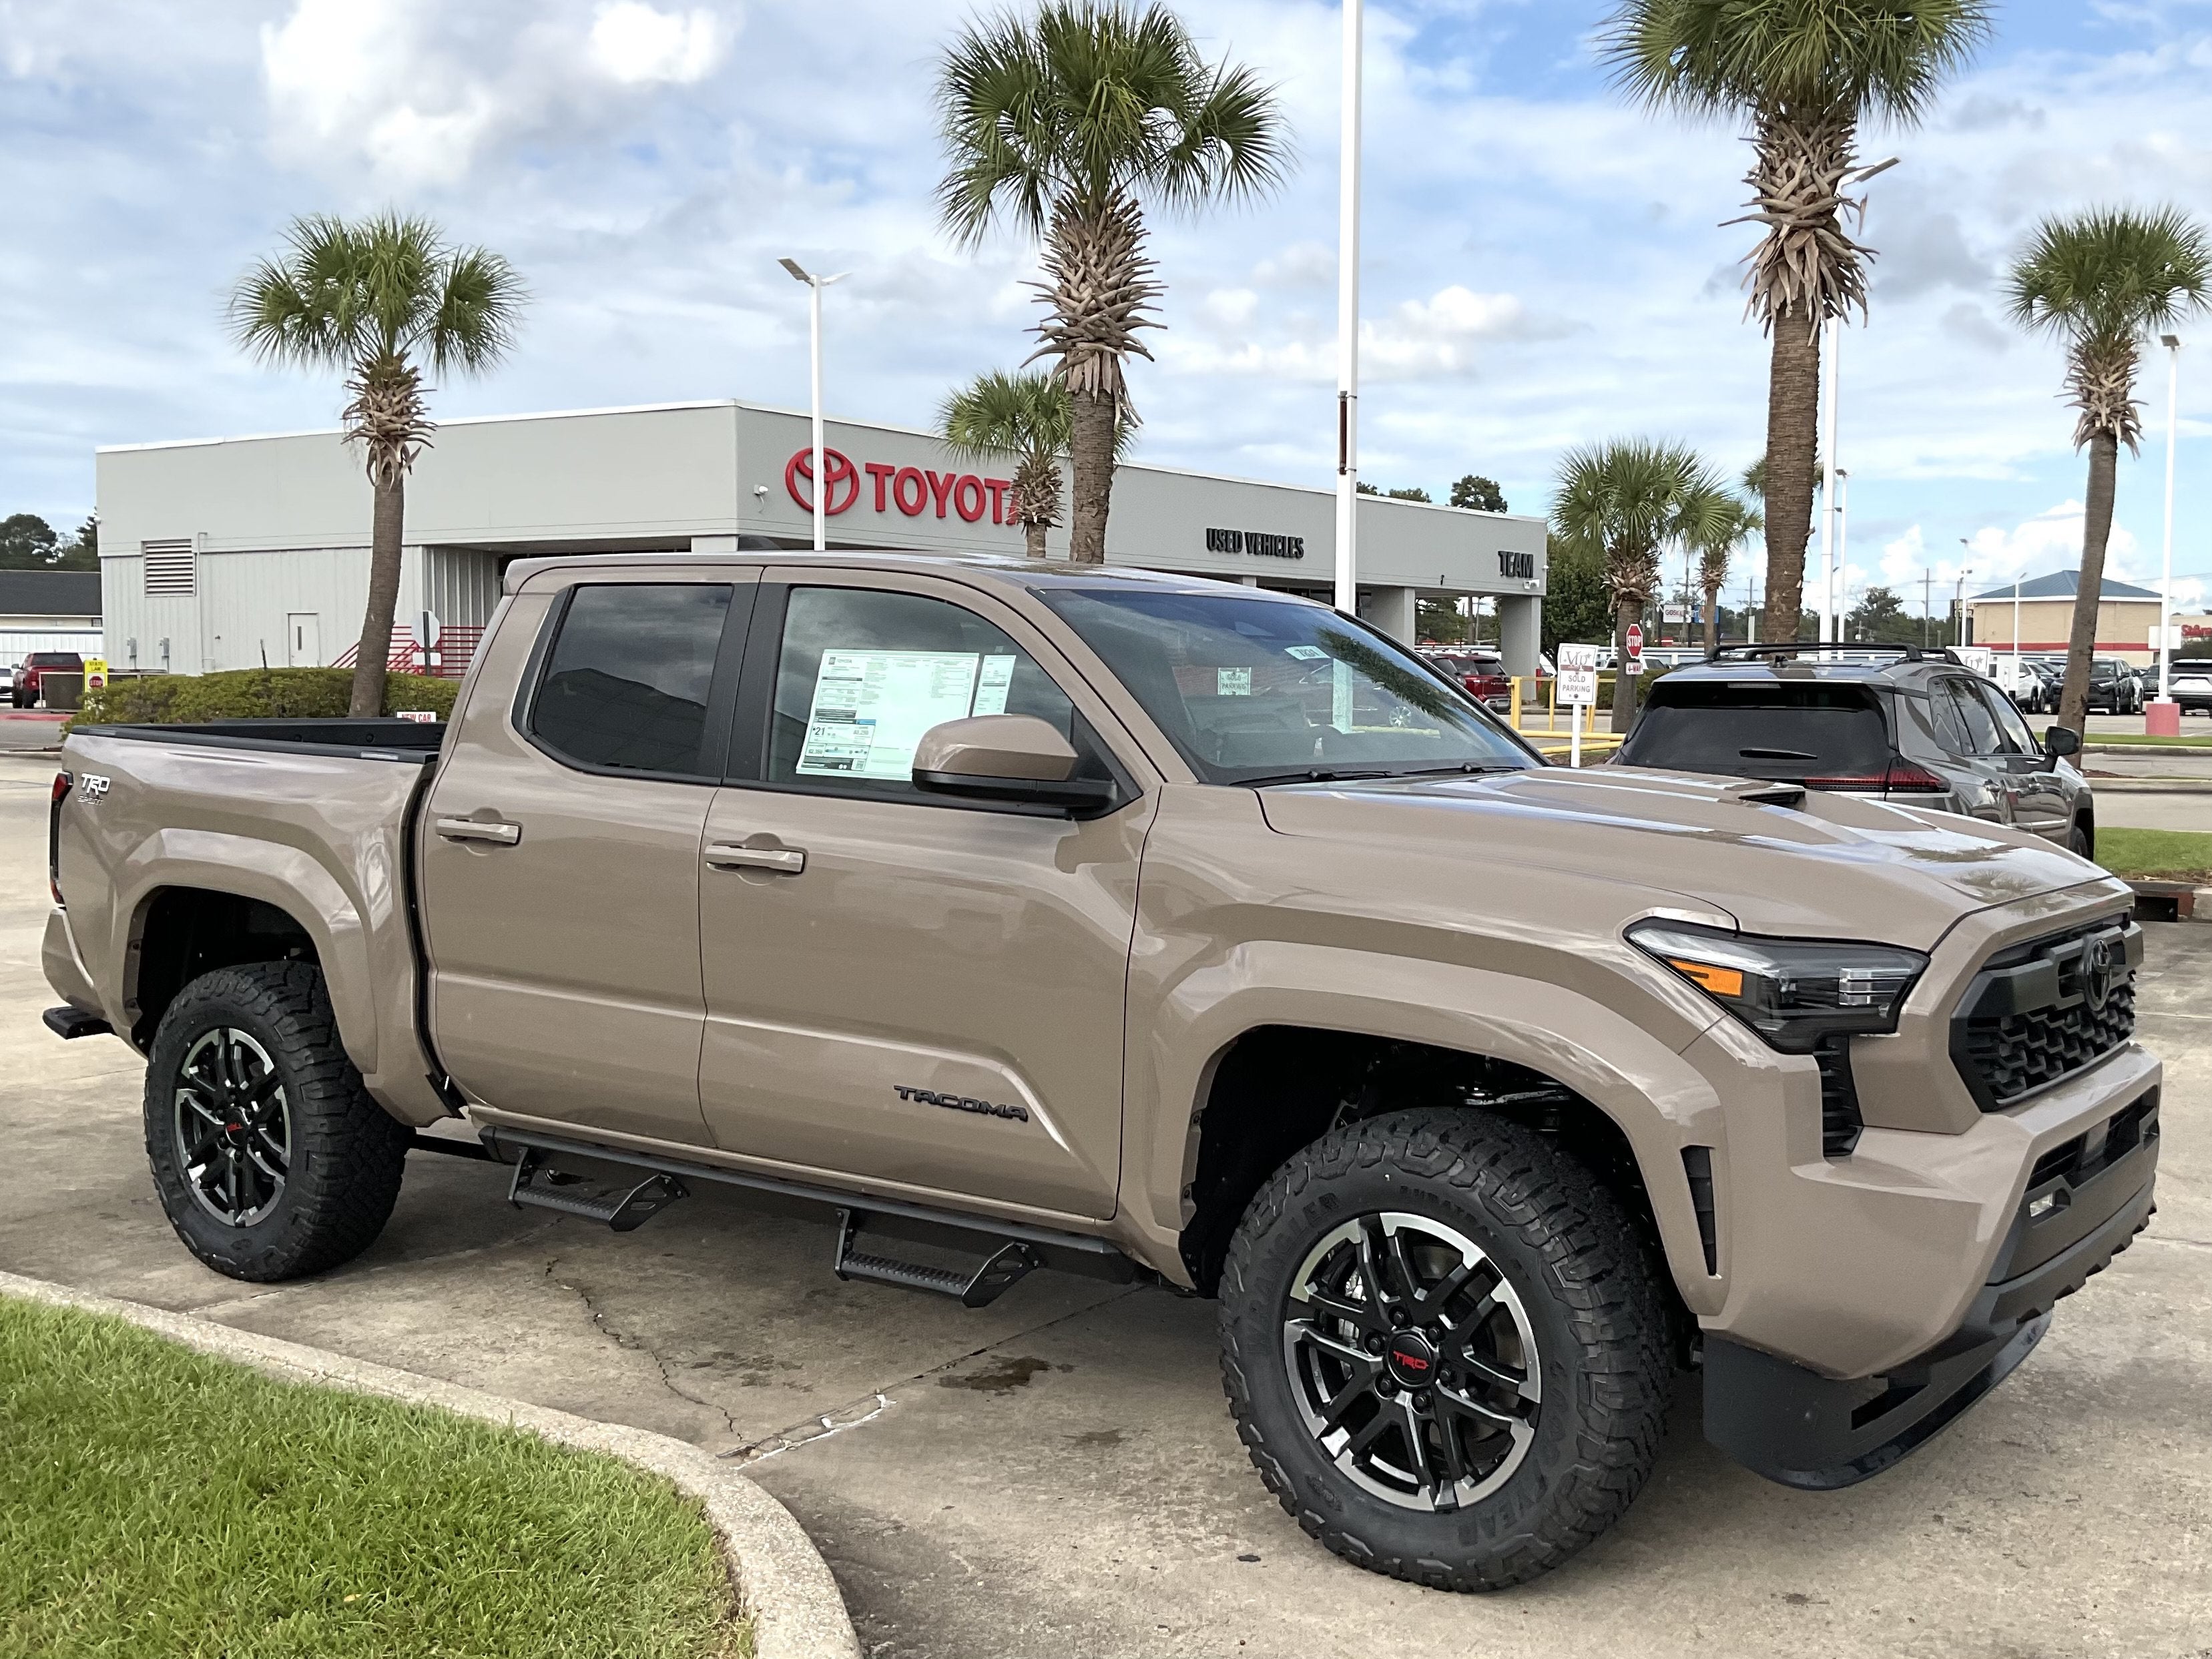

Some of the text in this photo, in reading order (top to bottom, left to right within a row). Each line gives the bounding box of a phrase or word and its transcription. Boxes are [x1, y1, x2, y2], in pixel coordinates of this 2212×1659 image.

[1206, 528, 1304, 559] USED VEHICLES
[1498, 551, 1533, 578] TEAM
[1627, 635, 1642, 647] STOP
[1628, 665, 1641, 673] 4-WAY
[1568, 675, 1586, 683] SOLD
[1562, 684, 1591, 693] PARKING
[418, 713, 431, 722] CAR
[81, 773, 110, 795] TRD
[893, 1084, 1029, 1122] TACOMA
[1392, 1350, 1429, 1370] TRD
